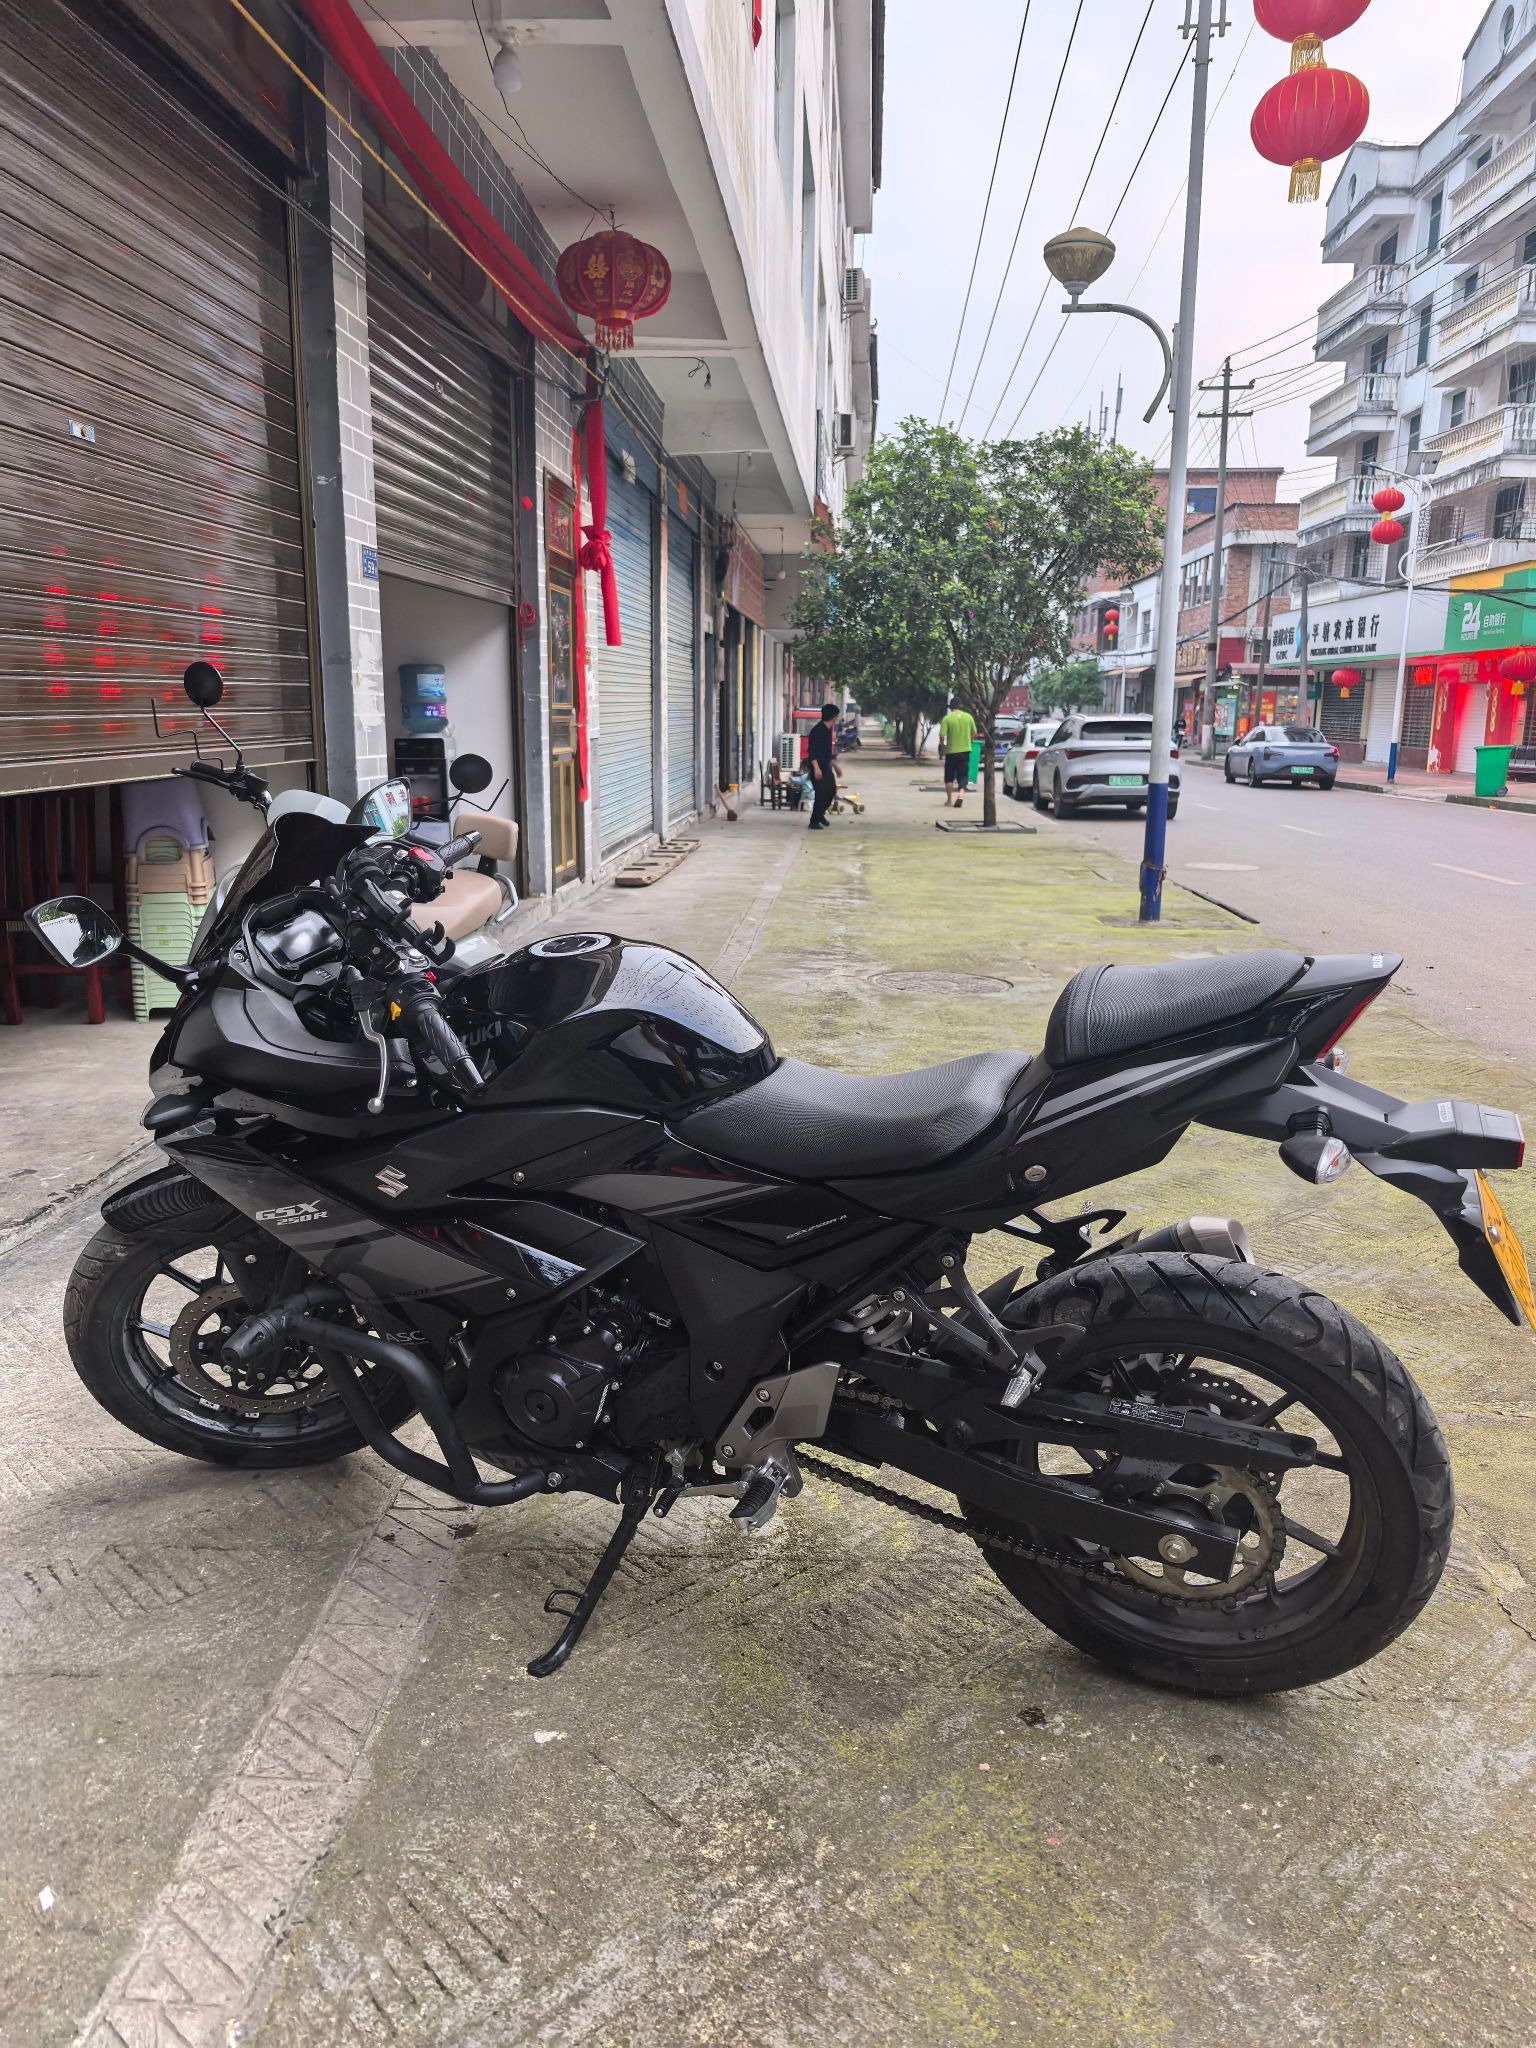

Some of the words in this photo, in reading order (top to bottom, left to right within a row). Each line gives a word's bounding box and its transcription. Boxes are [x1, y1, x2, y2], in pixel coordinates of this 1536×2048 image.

[1461, 599, 1481, 640] 24
[256, 1199, 321, 1221] GSX
[386, 1330, 427, 1342] ASC
